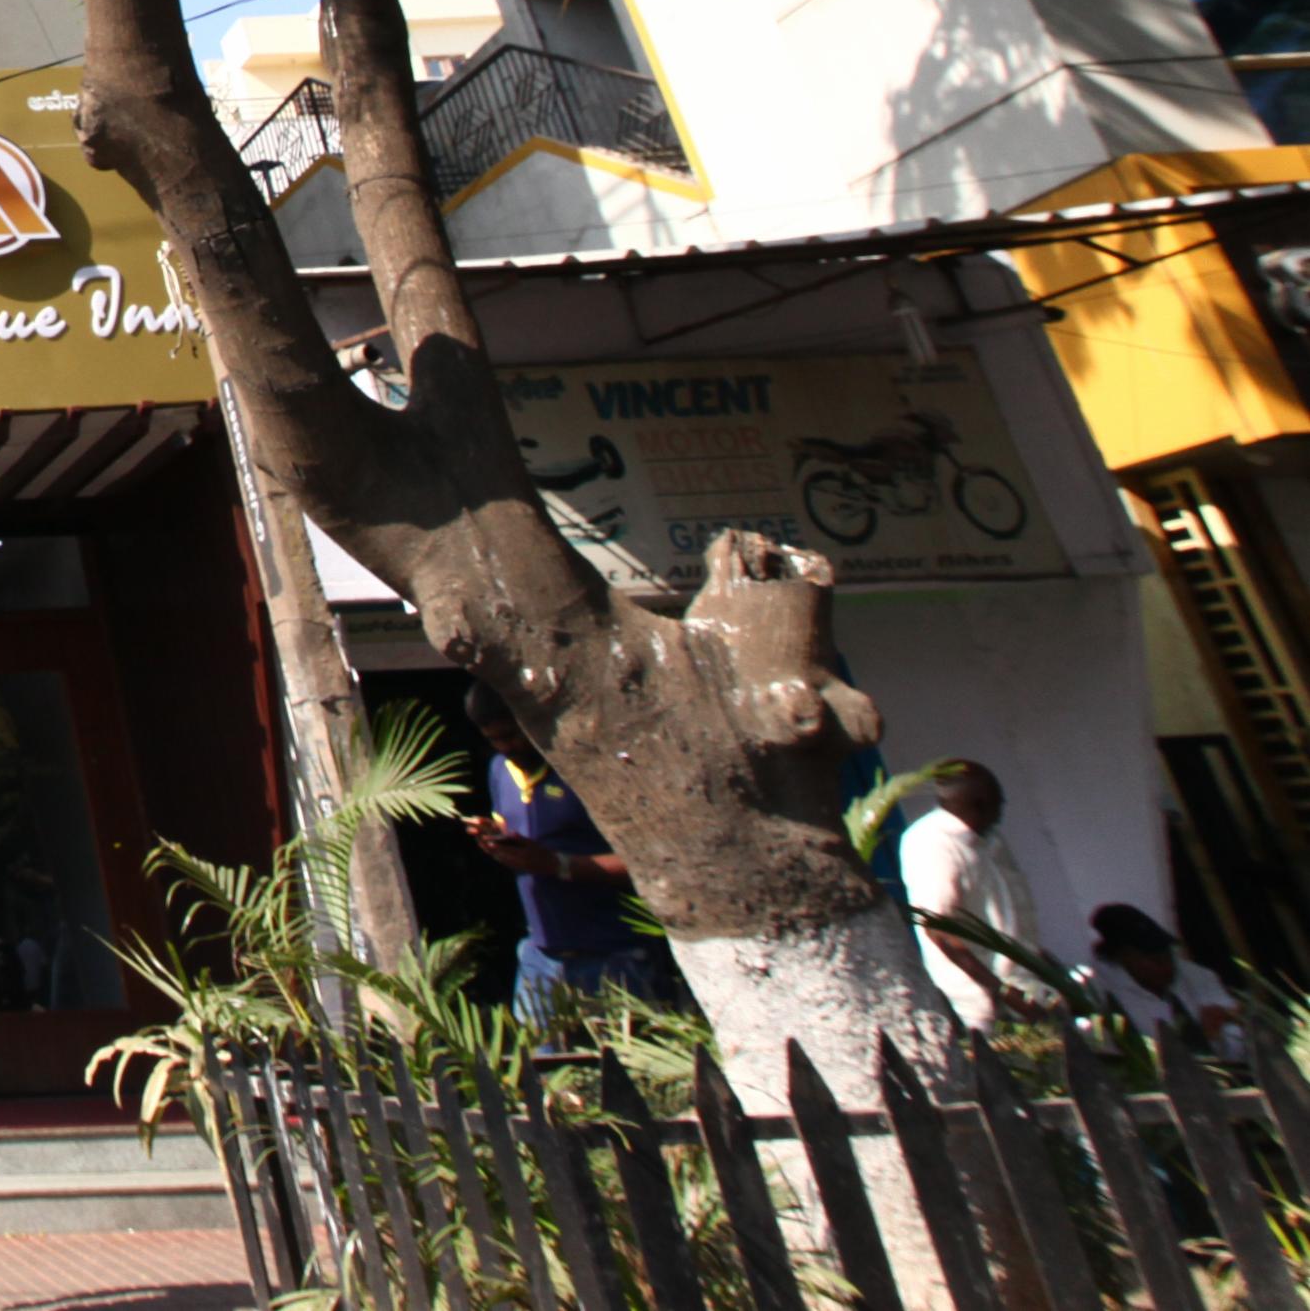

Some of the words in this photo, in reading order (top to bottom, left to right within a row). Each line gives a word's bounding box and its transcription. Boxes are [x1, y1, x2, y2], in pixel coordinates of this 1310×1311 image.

[585, 375, 773, 421] VINCENT
[636, 426, 766, 456] MOTOR
[650, 460, 780, 491] BIKES
[668, 517, 807, 550] GAGE
[840, 555, 924, 571] Motor
[936, 551, 1014, 568] Bikes
